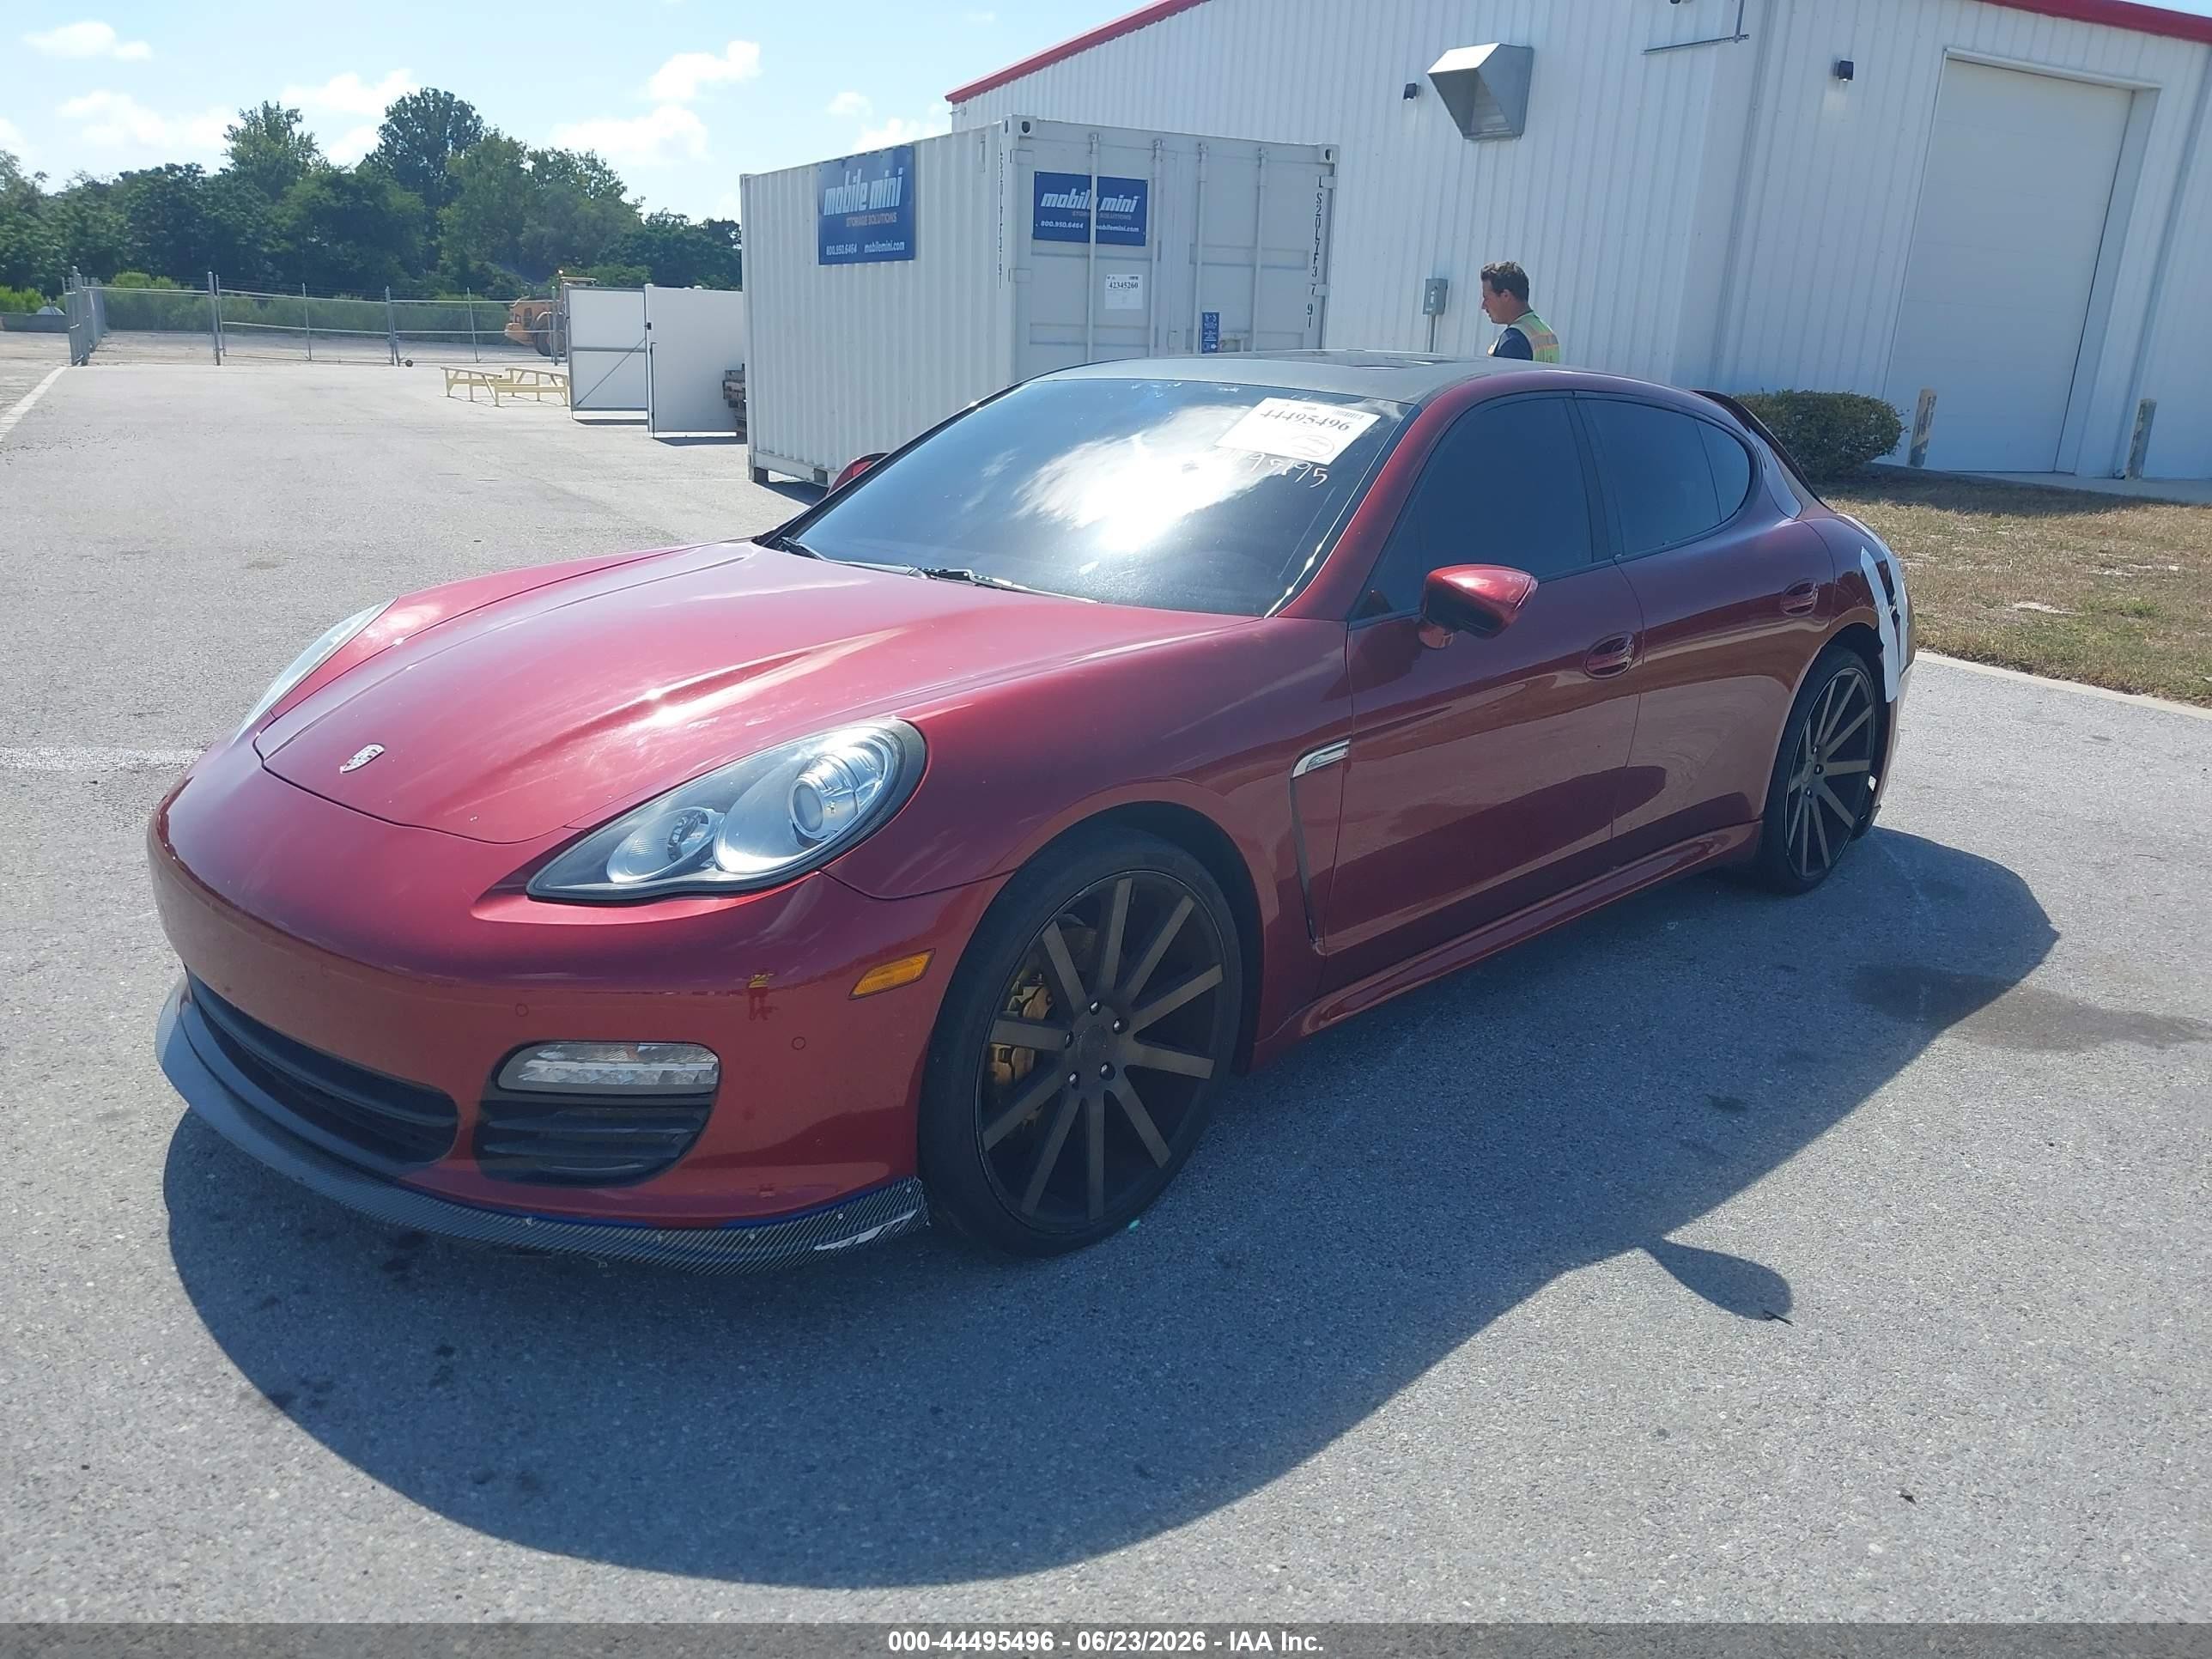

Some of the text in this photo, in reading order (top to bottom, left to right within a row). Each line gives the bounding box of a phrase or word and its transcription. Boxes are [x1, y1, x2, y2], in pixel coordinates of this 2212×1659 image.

[823, 167, 903, 216] mobile mini
[1099, 194, 1139, 213] mini
[864, 240, 905, 253] mobilemini.com
[1109, 281, 1139, 289] 42345260
[1260, 409, 1351, 432] 44495496
